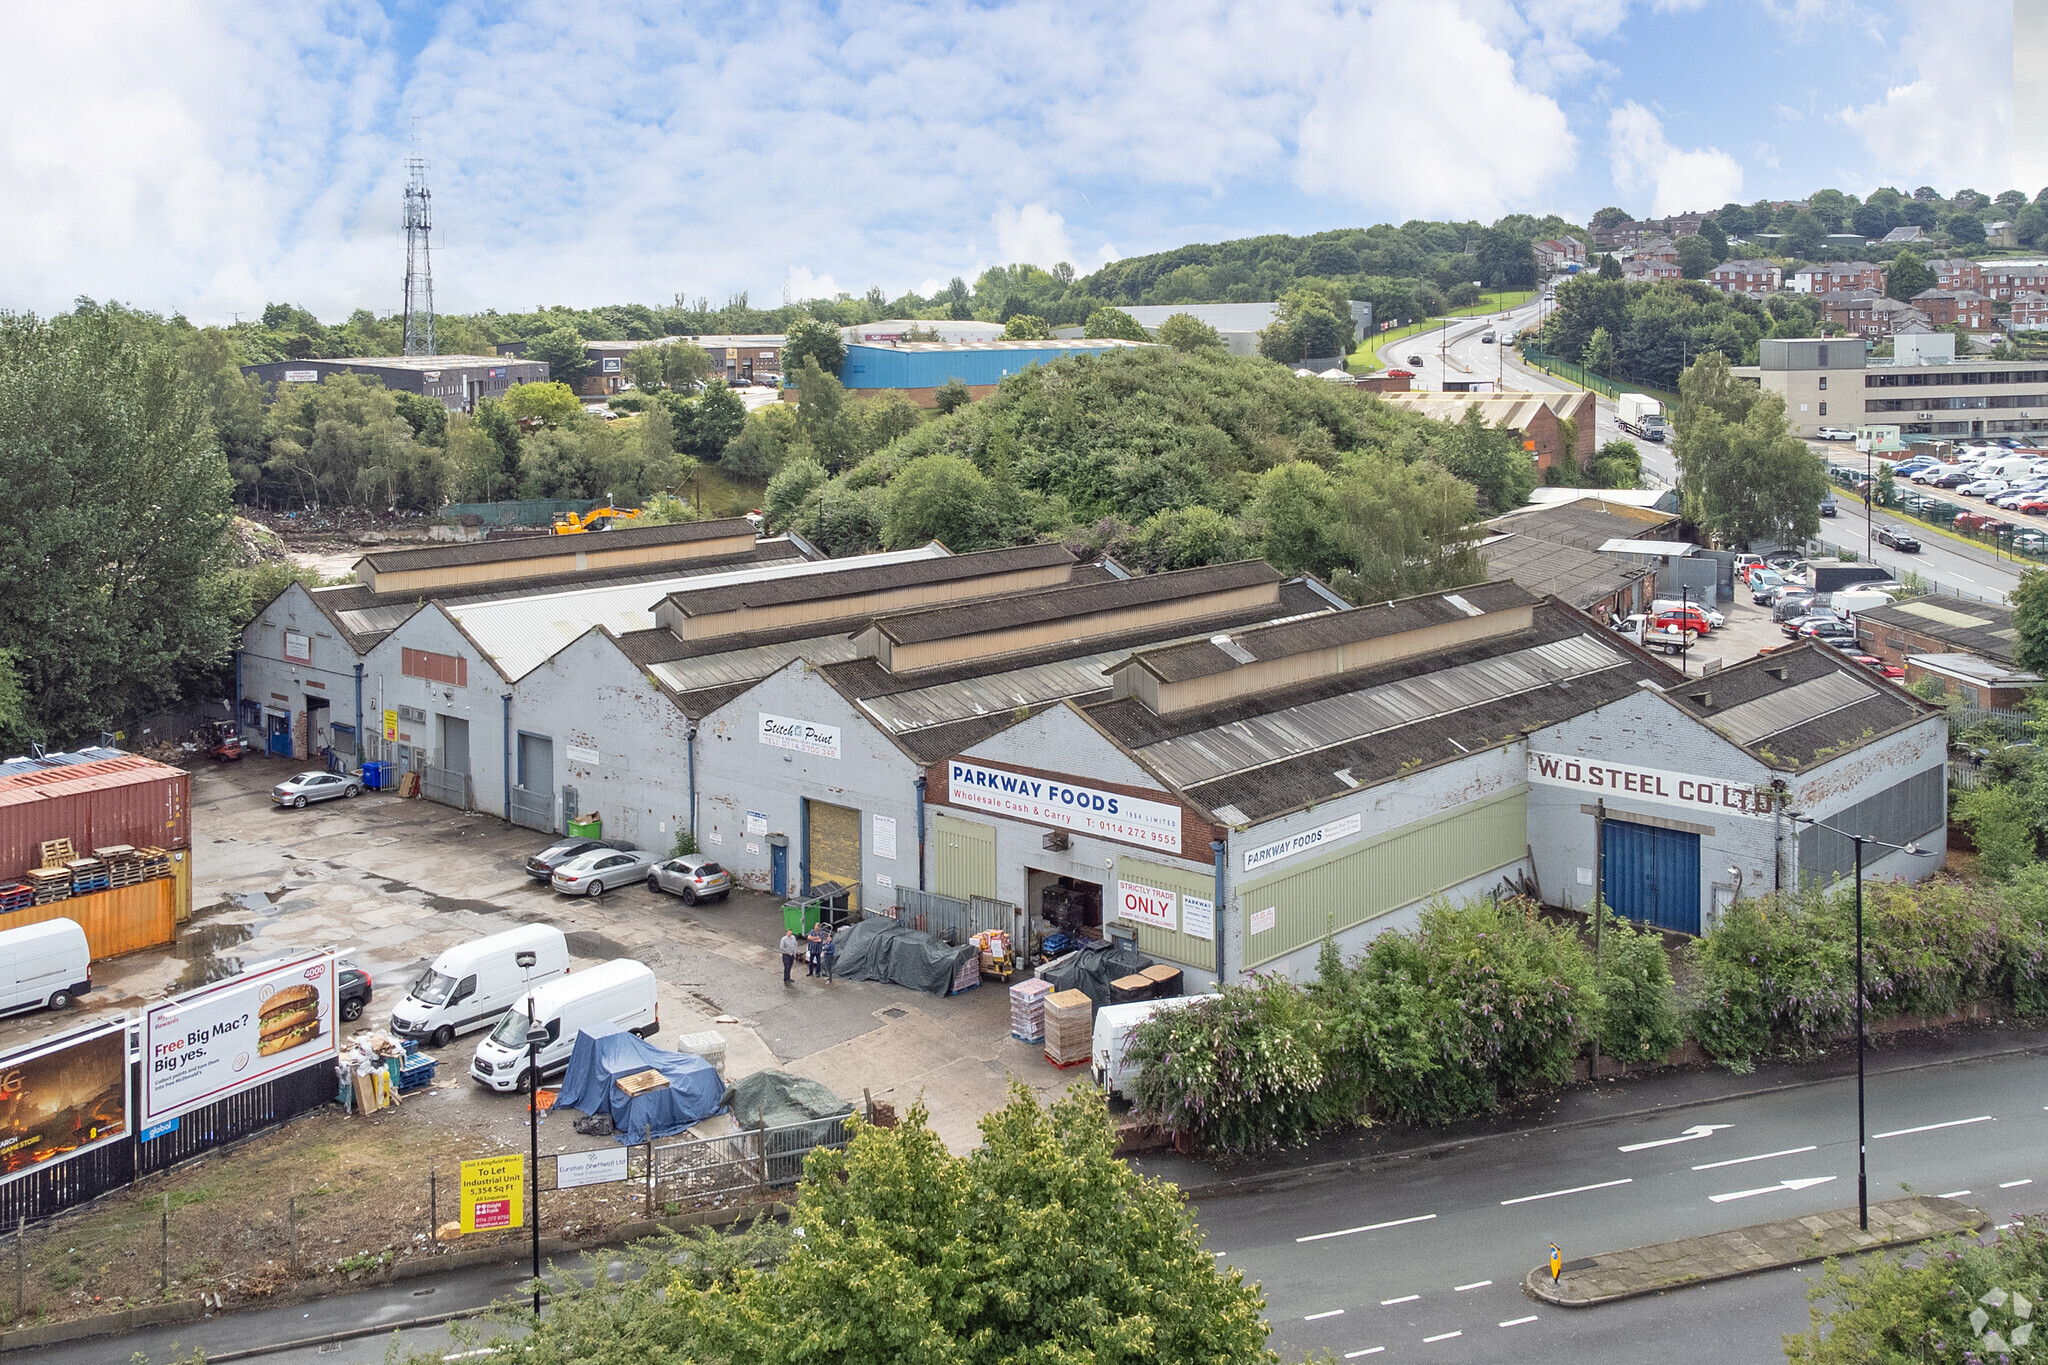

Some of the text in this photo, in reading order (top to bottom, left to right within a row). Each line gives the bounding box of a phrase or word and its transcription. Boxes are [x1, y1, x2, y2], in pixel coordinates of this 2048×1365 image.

[764, 720, 832, 744] Stitch Print
[782, 741, 799, 749] 0114
[802, 745, 819, 754] 2700
[953, 766, 1119, 815] PARKWAY FOODS
[953, 789, 1177, 846] Wholesale Cash & Carry T: 0114 272 9555
[1145, 815, 1176, 829] LIMITED
[1247, 840, 1291, 866] PARKWAY
[1292, 830, 1322, 850] FOODS
[1120, 882, 1175, 901] STRICTLY TRADE
[1125, 894, 1169, 918] ONLY
[1184, 898, 1212, 909] PARKWAY
[1155, 920, 1175, 928] ALLOWED
[304, 965, 325, 978] 4000
[155, 1018, 179, 1030] Rewards
[155, 1039, 184, 1058] Free
[187, 1029, 209, 1046] Big
[154, 1047, 207, 1073] Big yes.
[155, 1076, 172, 1085] Collect
[173, 1070, 187, 1079] points
[176, 1071, 202, 1083] McDonald's
[148, 1121, 172, 1139] global
[1, 1135, 40, 1155] GAME STORE
[478, 1167, 505, 1176] To Let
[559, 1165, 584, 1173] Eurofab
[585, 1160, 614, 1170] (Sheffield)
[463, 1176, 502, 1187] Industrial
[470, 1186, 492, 1196] 5,354
[494, 1185, 504, 1193] Sq
